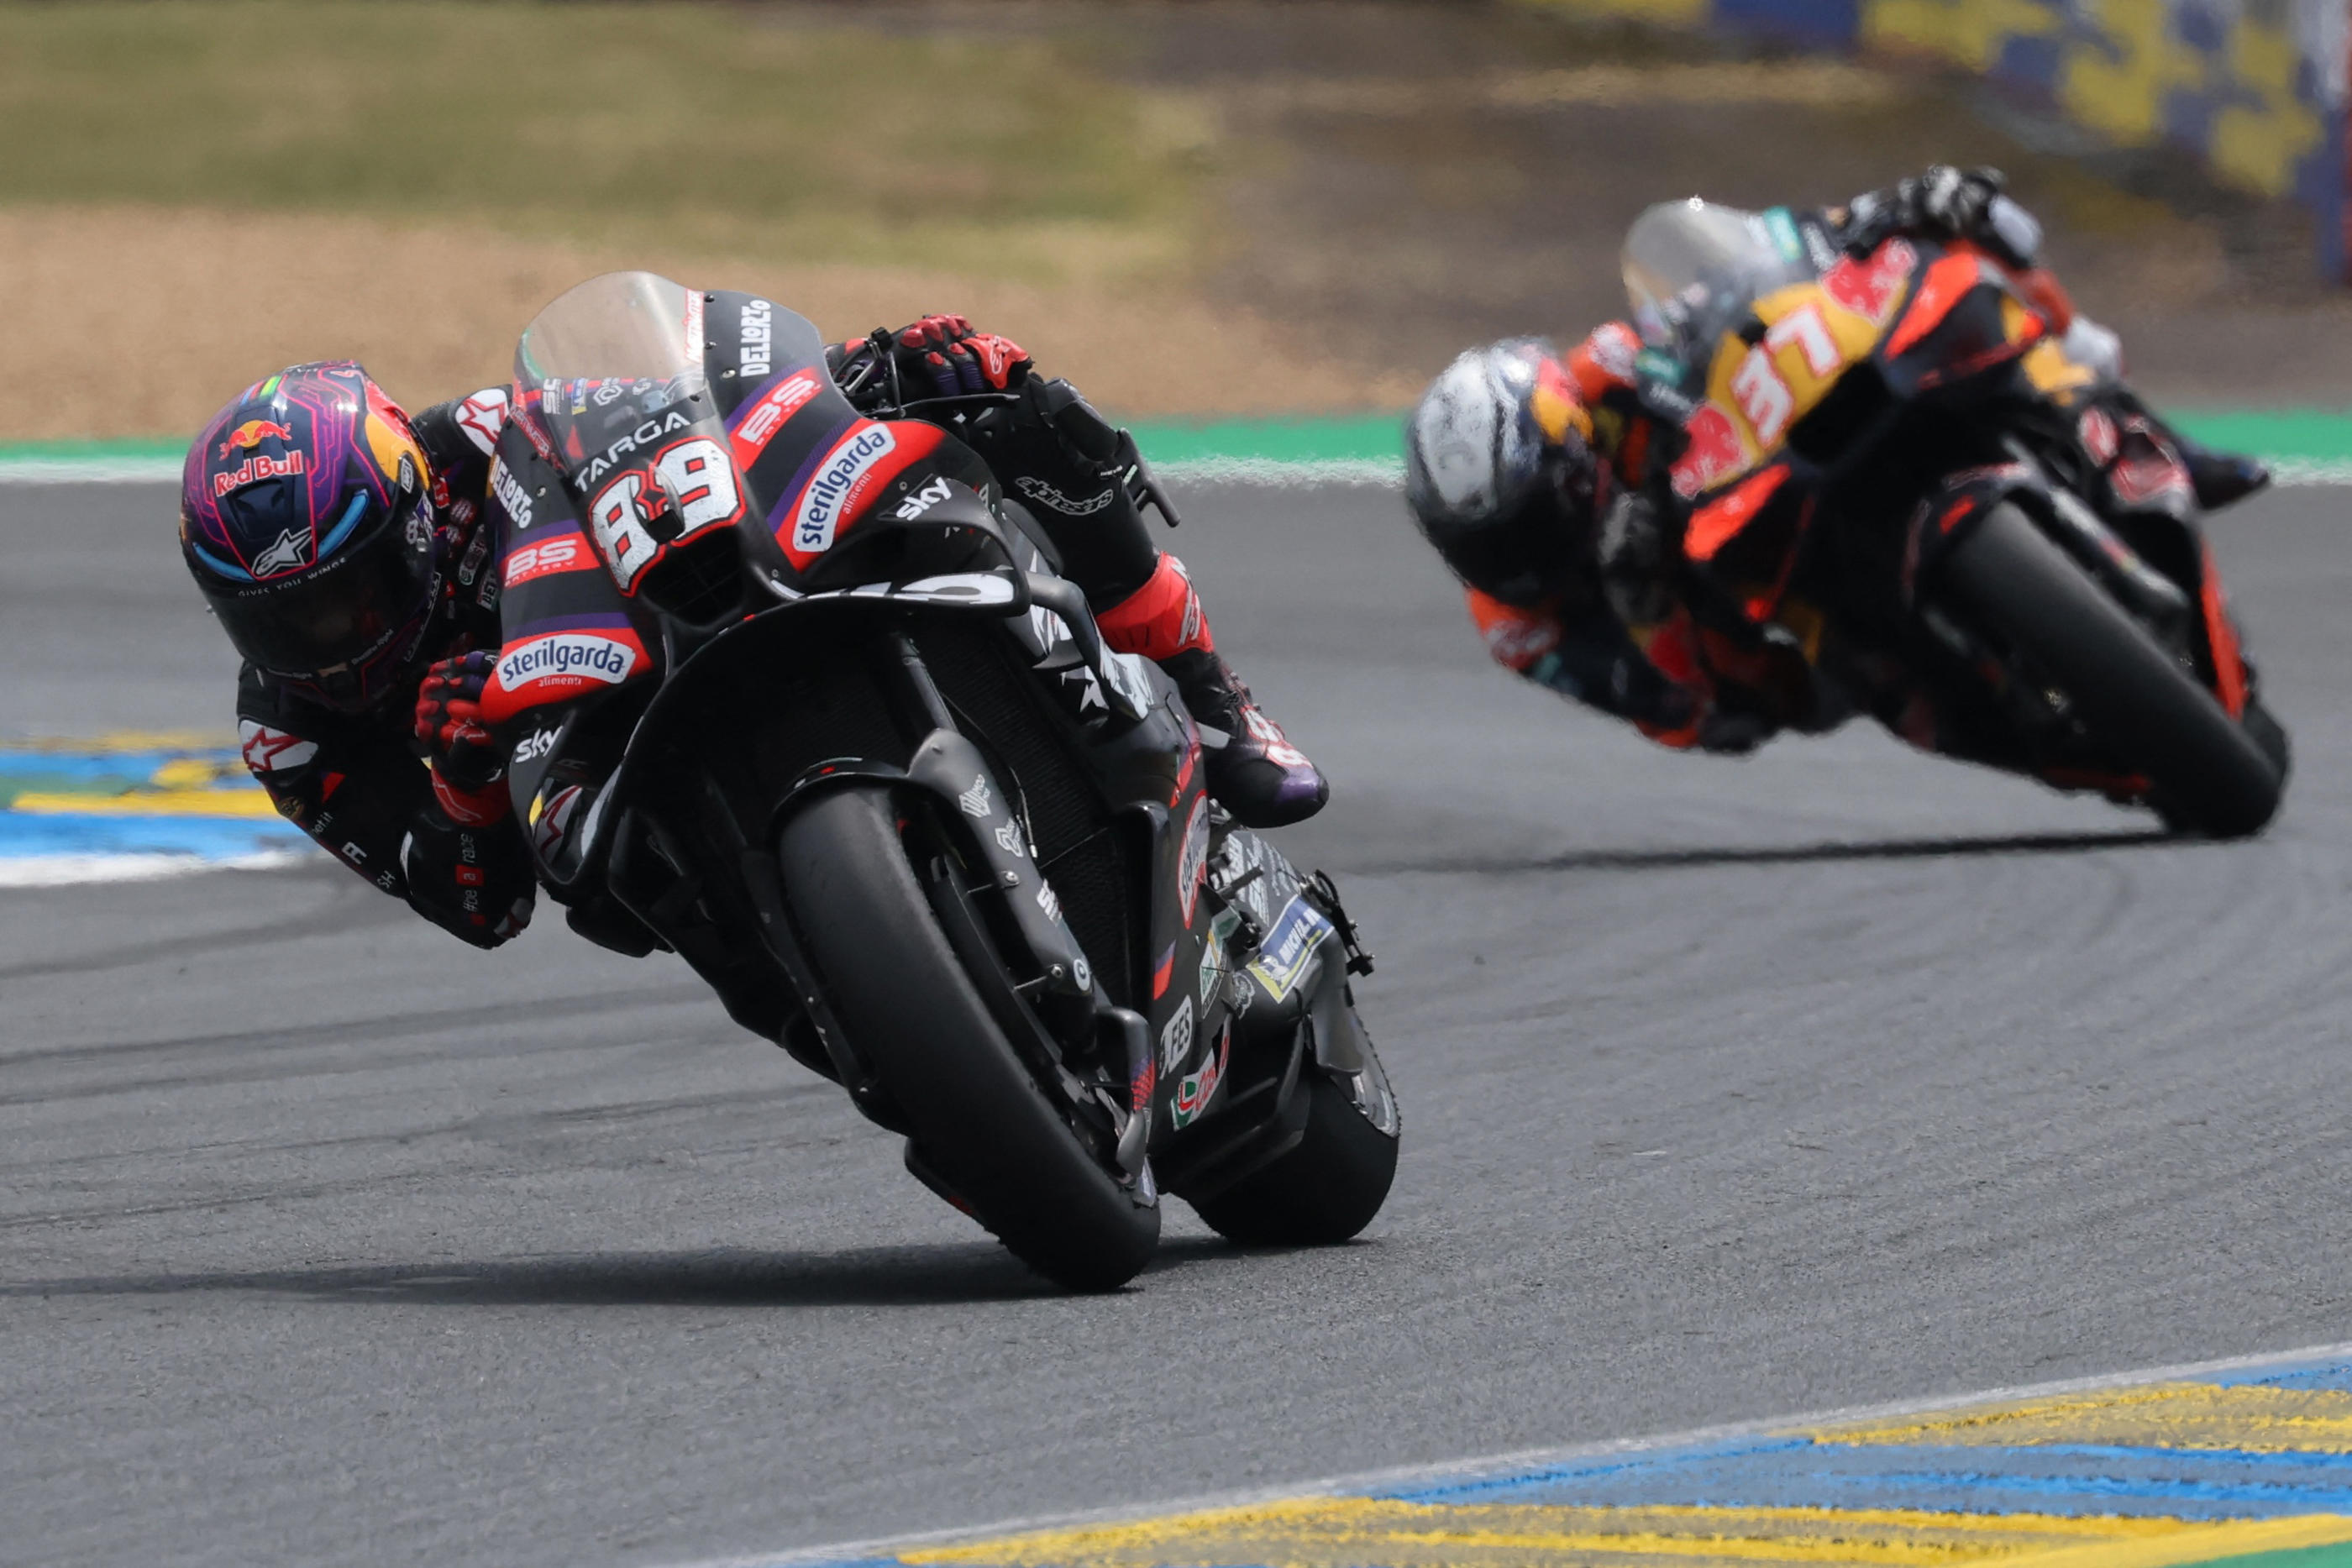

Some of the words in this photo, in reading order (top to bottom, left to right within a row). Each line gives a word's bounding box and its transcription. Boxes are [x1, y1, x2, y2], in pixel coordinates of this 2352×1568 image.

[1733, 304, 1840, 447] 37
[738, 376, 815, 443] BS
[214, 458, 253, 497] Red
[253, 449, 303, 480] Bull
[575, 412, 690, 492] TARGA
[801, 431, 886, 544] sterilgarda
[843, 472, 872, 515] alimenti
[896, 476, 952, 521] sky
[591, 438, 741, 590] 89
[506, 538, 579, 580] BS
[503, 639, 625, 682] sterilgarda
[538, 676, 582, 687] alimenti
[516, 726, 564, 763] sky
